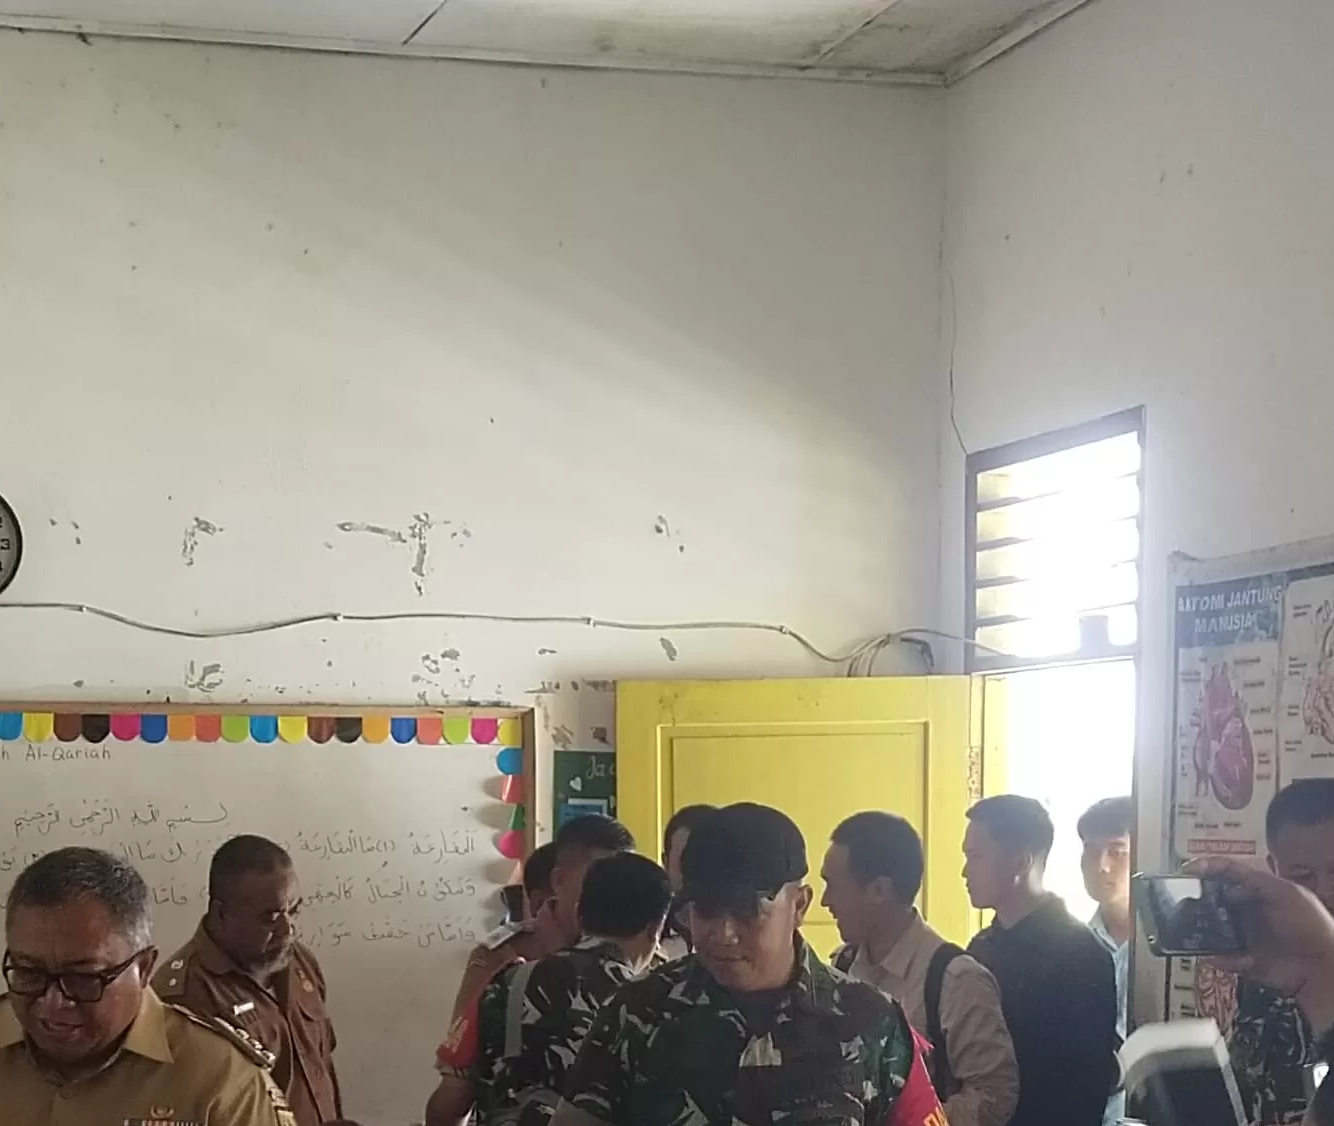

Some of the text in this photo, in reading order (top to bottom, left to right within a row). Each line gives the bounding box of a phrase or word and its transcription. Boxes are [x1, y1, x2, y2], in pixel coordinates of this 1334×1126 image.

[0, 538, 11, 550] 3
[1227, 585, 1282, 609] JANTUNG
[25, 744, 111, 762] Al-Qariah
